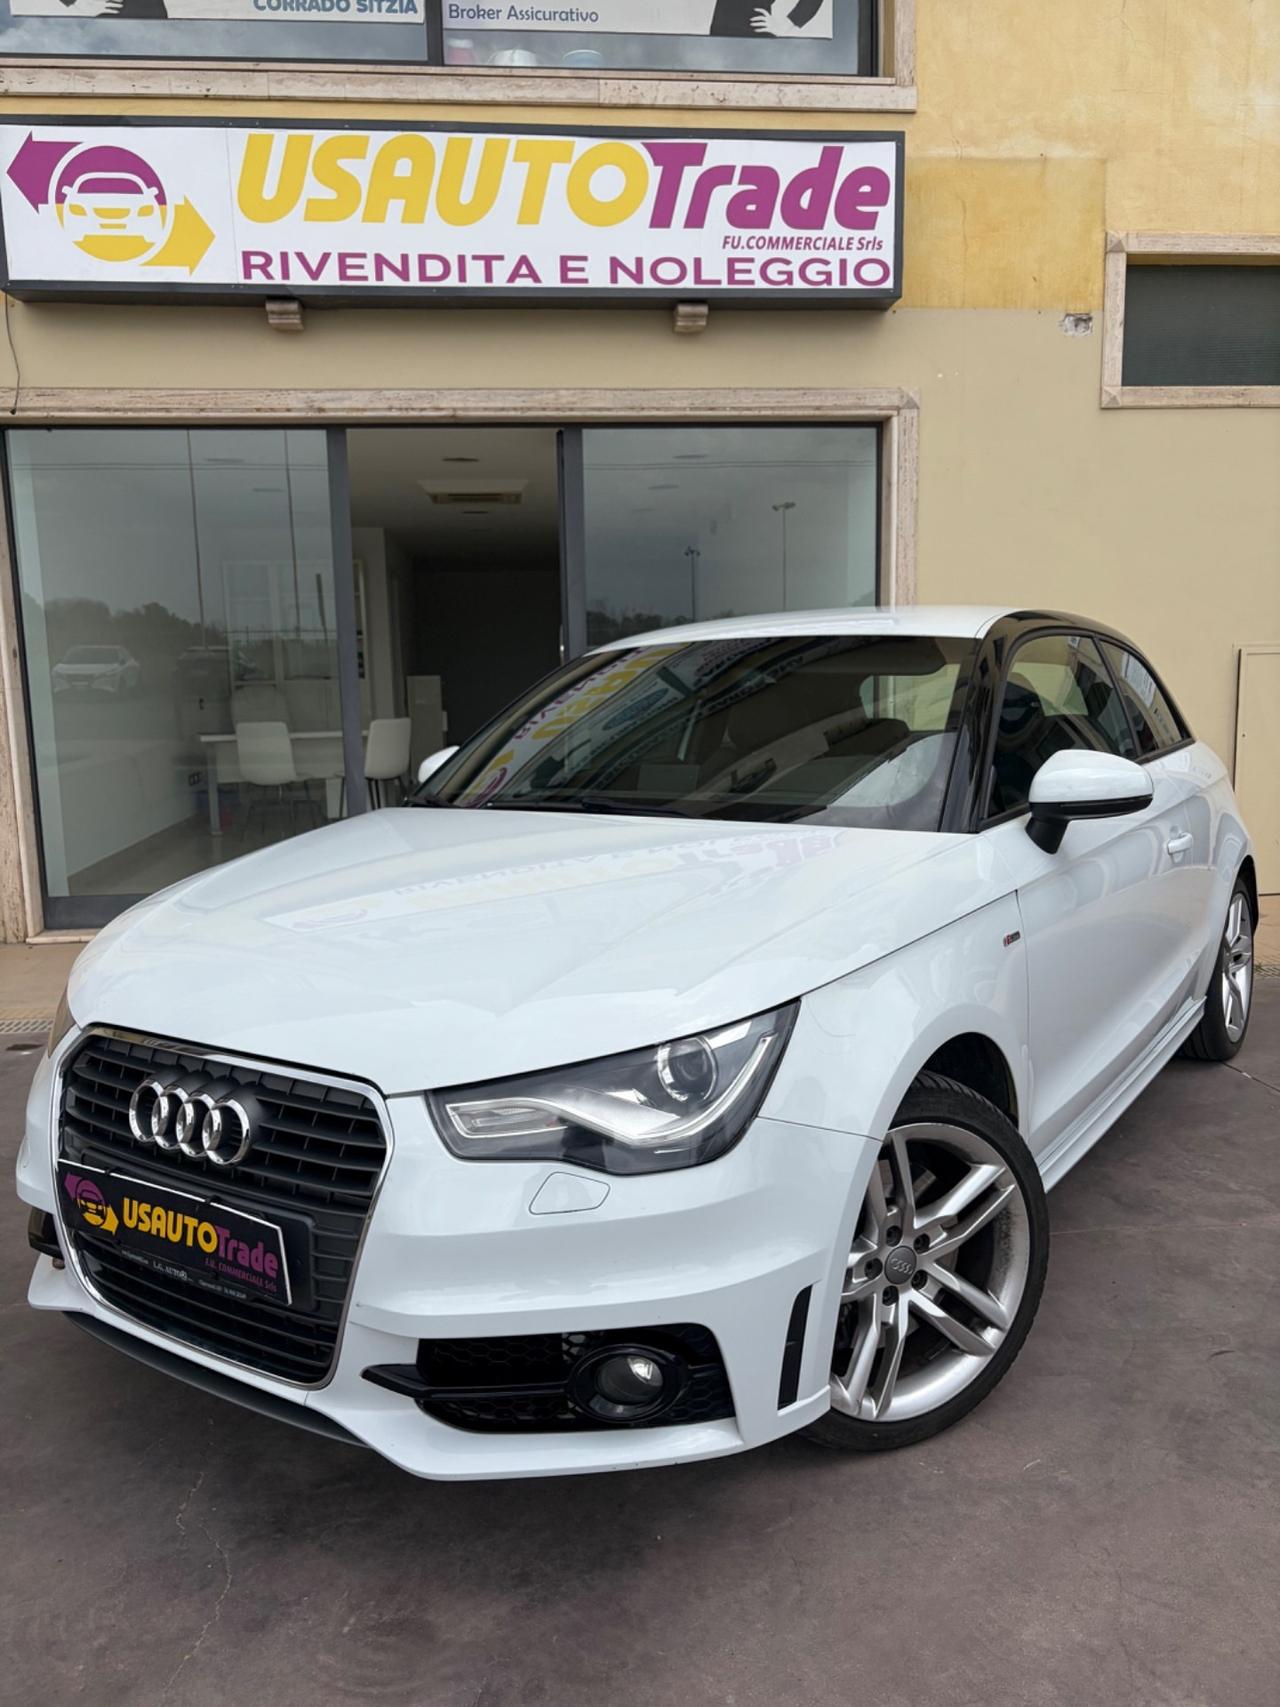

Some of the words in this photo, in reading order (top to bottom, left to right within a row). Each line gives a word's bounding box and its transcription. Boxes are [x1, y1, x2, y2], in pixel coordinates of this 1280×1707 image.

[254, 0, 350, 12] CORRADO
[356, 0, 418, 14] SITZIA
[448, 3, 502, 20] Broker
[507, 5, 599, 23] Assicurativo
[856, 236, 883, 251] Srls
[241, 250, 542, 284] RIVENDITA
[560, 255, 589, 284] E
[609, 256, 891, 286] NOLEGGIO
